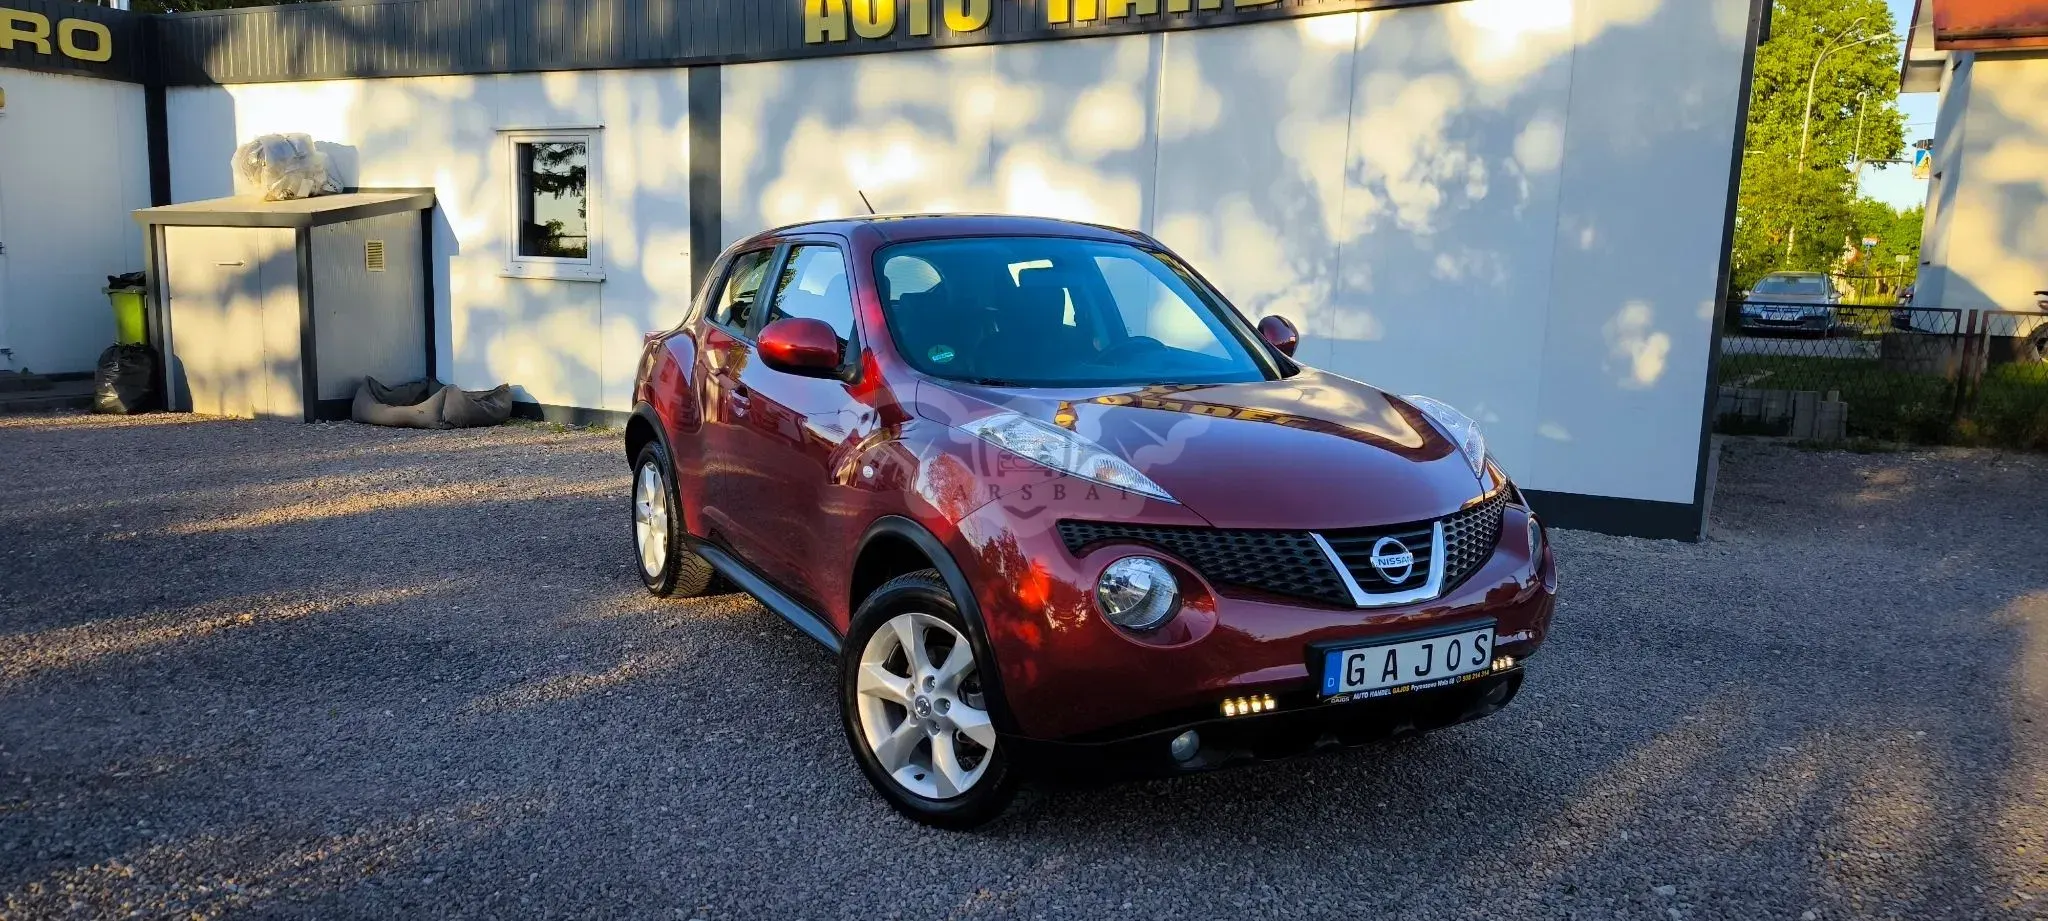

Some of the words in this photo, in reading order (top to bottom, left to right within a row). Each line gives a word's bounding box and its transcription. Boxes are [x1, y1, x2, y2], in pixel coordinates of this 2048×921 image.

[1377, 555, 1412, 566] NISSAN
[1346, 633, 1488, 687] GAJOS
[1353, 691, 1369, 700] AUTO
